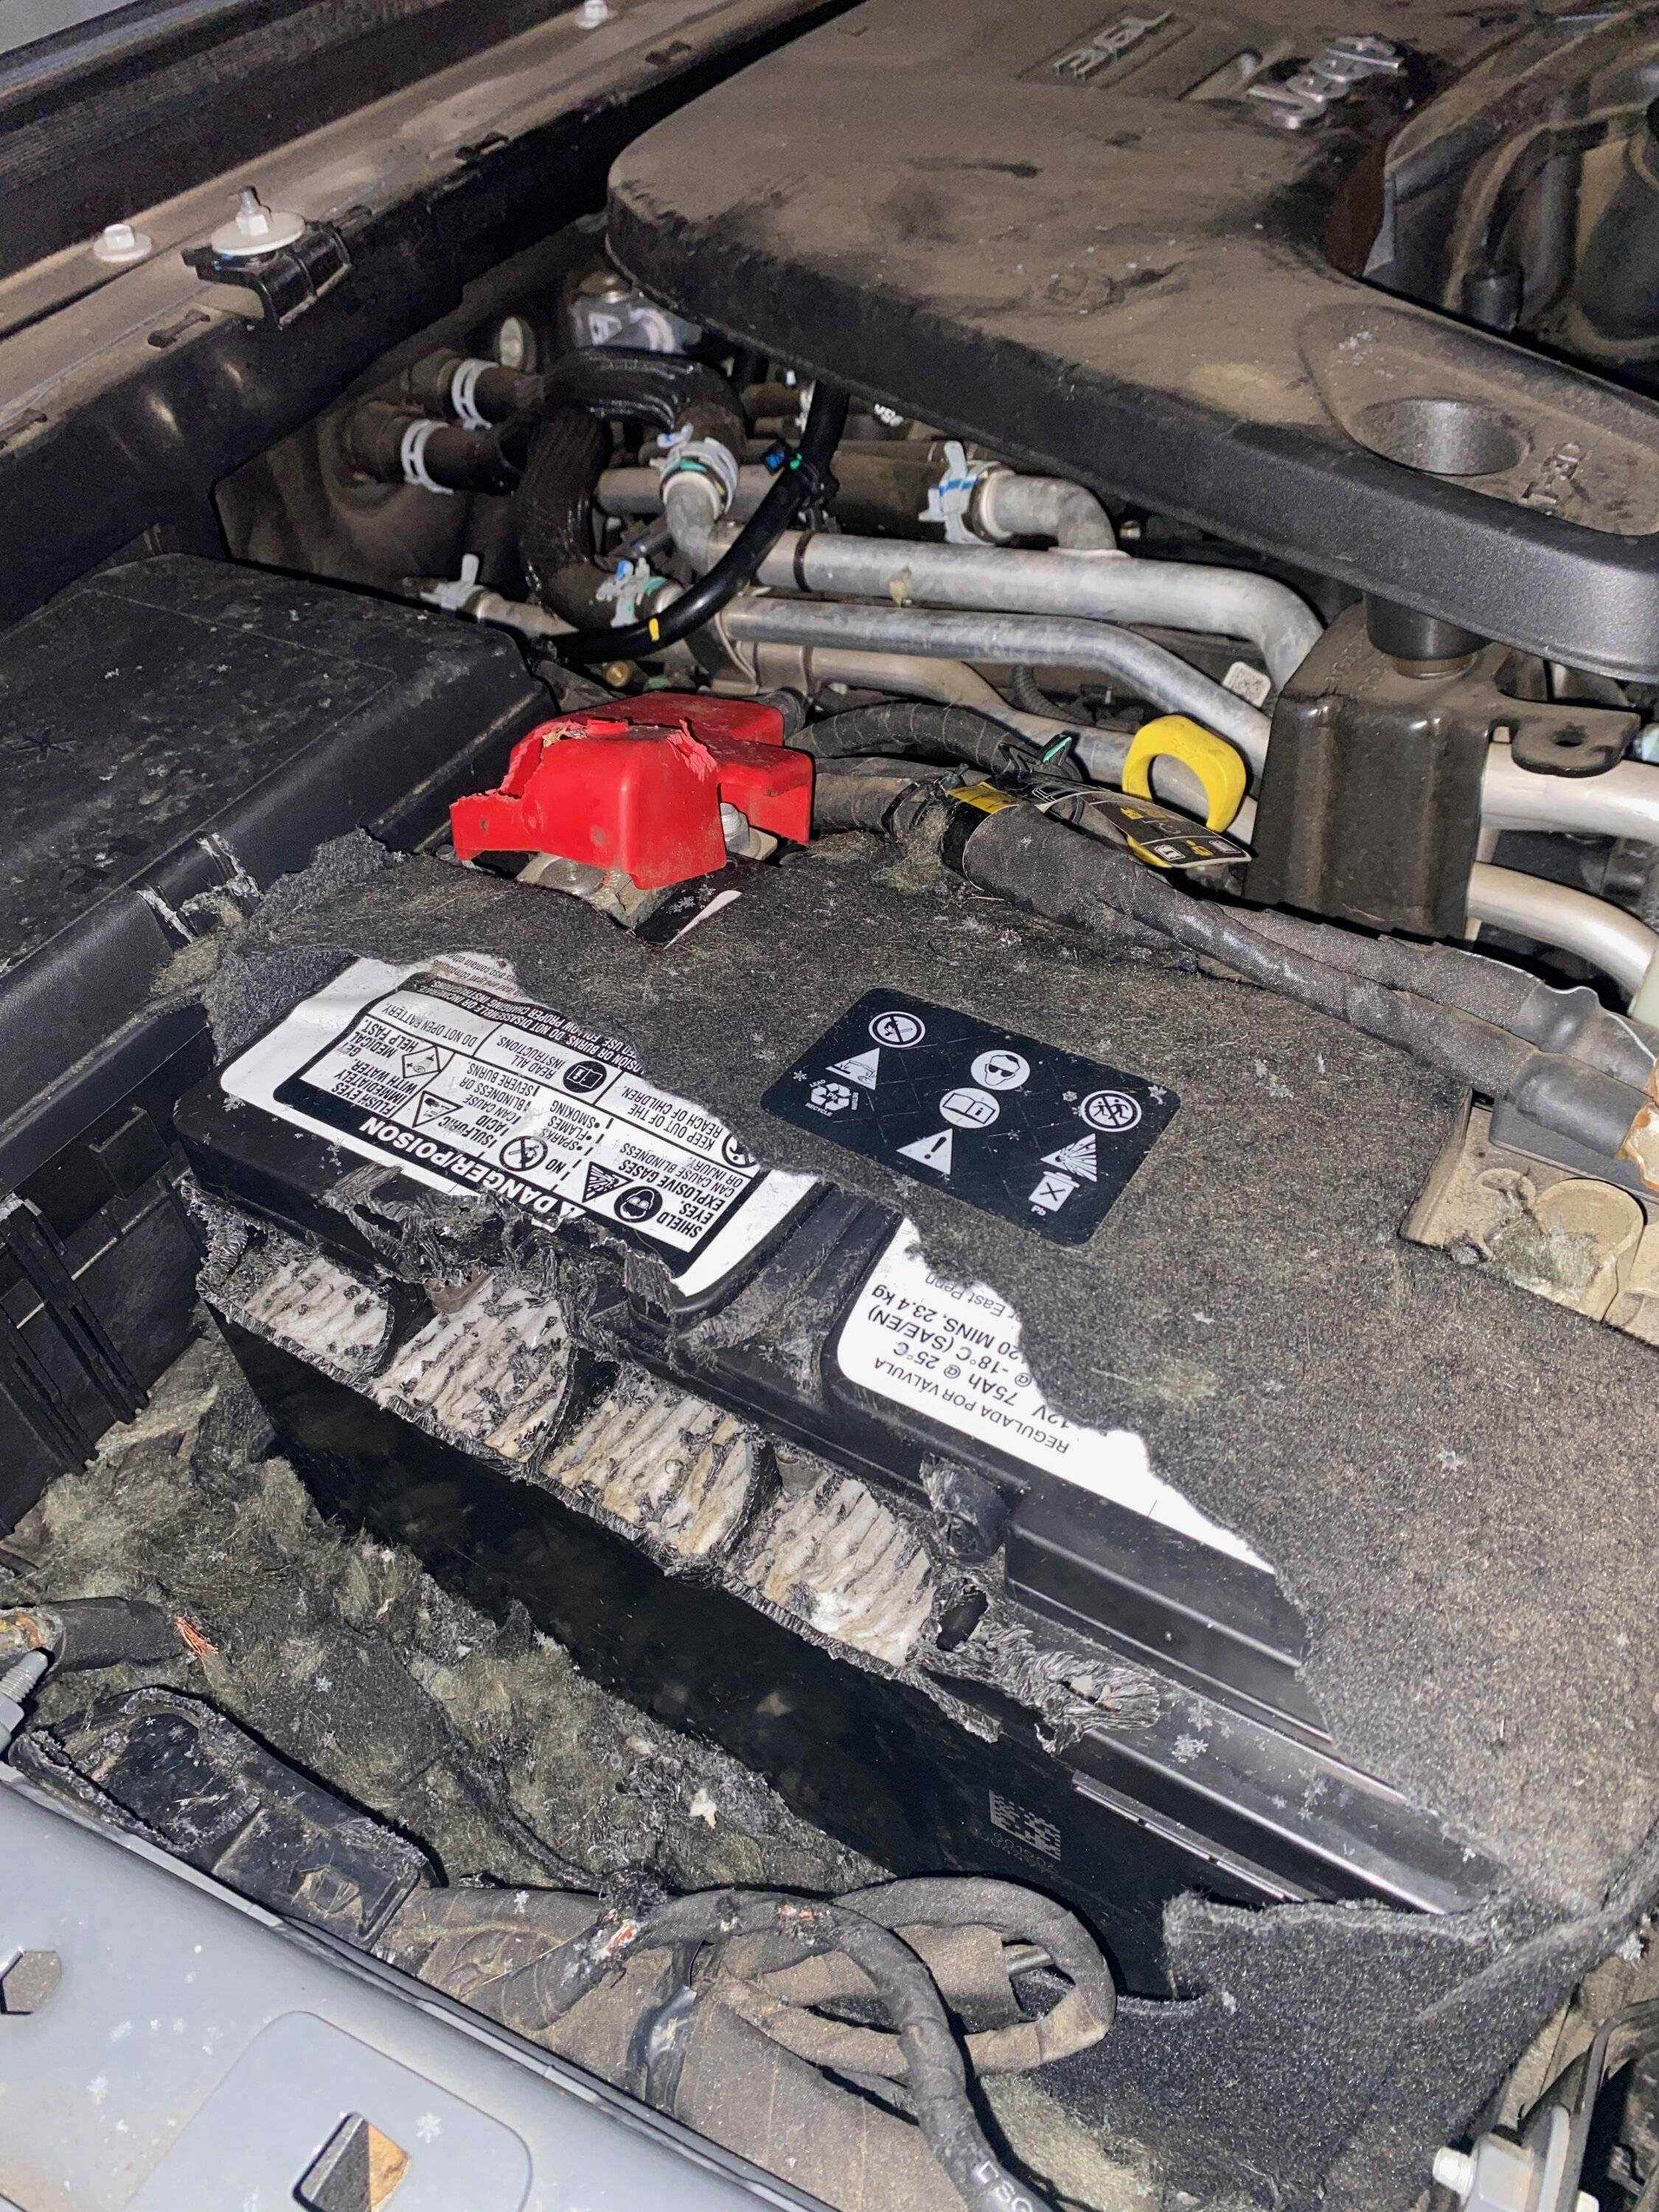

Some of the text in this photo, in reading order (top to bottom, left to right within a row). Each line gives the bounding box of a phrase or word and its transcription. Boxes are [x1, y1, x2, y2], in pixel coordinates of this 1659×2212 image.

[462, 958, 491, 973] contain
[461, 997, 478, 1010] OR
[473, 1003, 533, 1027] DISASSEMBLE
[487, 997, 529, 1015] CHARGING
[418, 1018, 445, 1035] OPEN
[526, 1007, 566, 1027] PROPER
[529, 1020, 551, 1034] NOT
[358, 1018, 419, 1052] HELP FAST.
[442, 1026, 462, 1042] NOT
[461, 1033, 478, 1048] DO
[547, 1026, 566, 1040] DO
[560, 1019, 601, 1042] FOOW
[338, 1040, 361, 1058] GET
[348, 1031, 397, 1058] MEDICAL
[496, 1034, 566, 1070] INSTRUCTIONS.
[565, 1033, 599, 1055] BURNS.
[597, 1046, 614, 1061] OR
[348, 1057, 417, 1095] WITH WATER.
[464, 1060, 535, 1096] SEVERE BURNS.
[510, 1054, 557, 1080] READ ALL
[330, 1080, 396, 1116] FLUSH EYES
[333, 1067, 407, 1105] IMMEDIATELY
[458, 1075, 526, 1110] BLINDNESS OR
[827, 1092, 838, 1100] Pb
[461, 1093, 517, 1122] CAN CAUSE
[549, 1099, 597, 1128] SMOKING
[620, 1085, 723, 1138] REACH OF CHILDREN.
[437, 1114, 494, 1147] SULFURIC
[474, 1113, 507, 1134] ACID
[546, 1114, 588, 1140] FLAMES
[627, 1102, 715, 1151] KEEP OUT OF THE
[539, 1127, 580, 1150] SPARKS
[358, 1115, 558, 1214] DANGER/POISON
[544, 1157, 566, 1175] NO
[619, 1141, 735, 1198] CAN CAUSE BLINDNESS
[686, 1156, 743, 1188] OR INJURY.
[617, 1158, 726, 1211] EXPLOSIVE GASES
[676, 1199, 714, 1225] EYES.
[1031, 1205, 1046, 1216] Pb
[655, 1209, 703, 1239] SHIELD
[870, 1281, 895, 1305] kg
[923, 1273, 965, 1300] Penn
[896, 1296, 937, 1324] 23.4
[966, 1291, 1006, 1317] East
[866, 1303, 1033, 1390] @ -18°C (SAE/EN)
[891, 1339, 940, 1371] 25°C
[995, 1339, 1023, 1364] 20
[942, 1361, 962, 1381] @
[965, 1371, 1018, 1407] 75Ah
[872, 1355, 1070, 1454] REGULADA POR VÁLVULA
